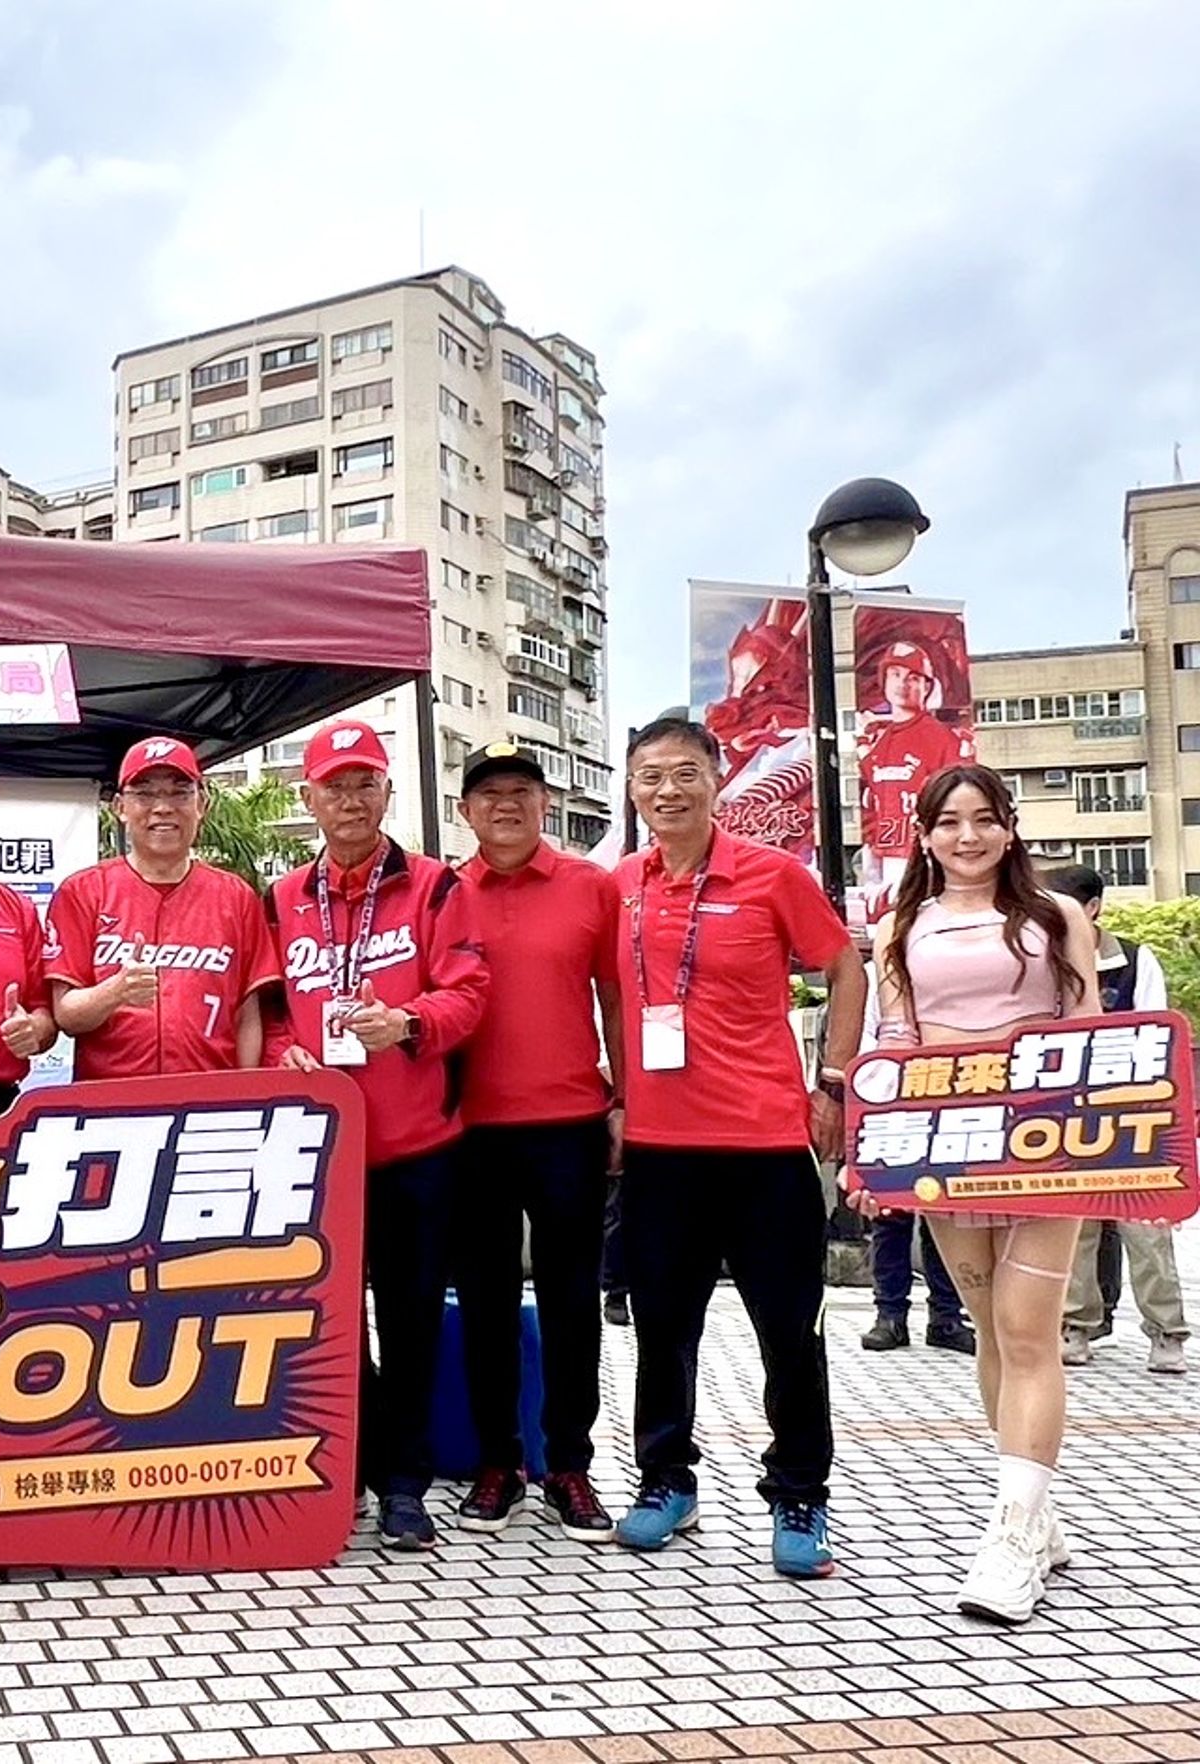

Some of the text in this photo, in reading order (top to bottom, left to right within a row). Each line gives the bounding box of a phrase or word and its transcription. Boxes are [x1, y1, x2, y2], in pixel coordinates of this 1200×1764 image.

[204, 993, 221, 1038] 7
[14, 1466, 117, 1499] 檢舉專線
[129, 1454, 298, 1489] 0800-007-007
